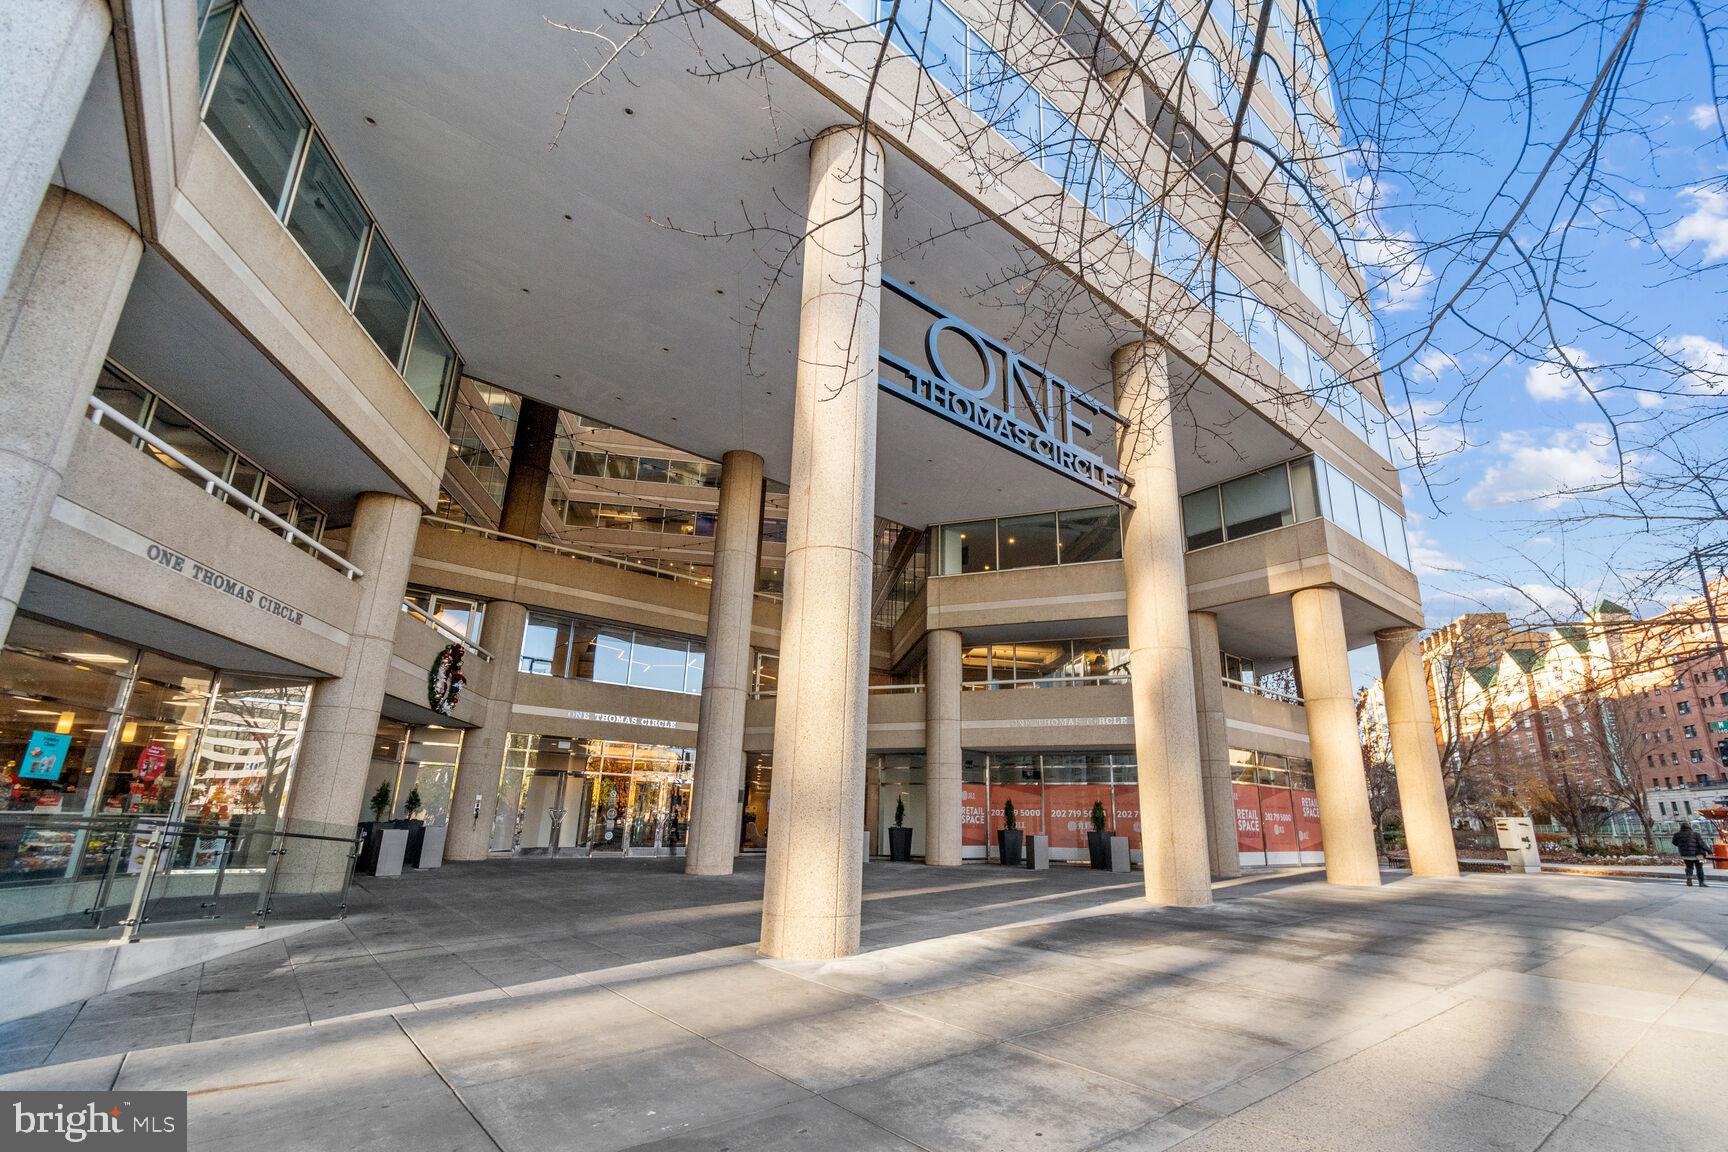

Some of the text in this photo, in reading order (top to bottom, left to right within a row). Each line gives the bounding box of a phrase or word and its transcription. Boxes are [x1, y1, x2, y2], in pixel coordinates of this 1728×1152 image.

[925, 317, 1103, 465] ONE
[907, 368, 1119, 493] THOMAS CIRCLE
[147, 544, 303, 626] ONE THOMAS CIRCLE
[567, 711, 677, 729] ONE THOMAS CIRCLE
[961, 806, 985, 816] RETAIL
[991, 809, 1005, 817] 202
[1020, 809, 1041, 817] 5000
[1051, 809, 1066, 818] 202
[1117, 810, 1133, 818] 202
[1236, 808, 1259, 820] RETAIL
[961, 815, 985, 824] SPACE
[1238, 820, 1260, 832] SPACE
